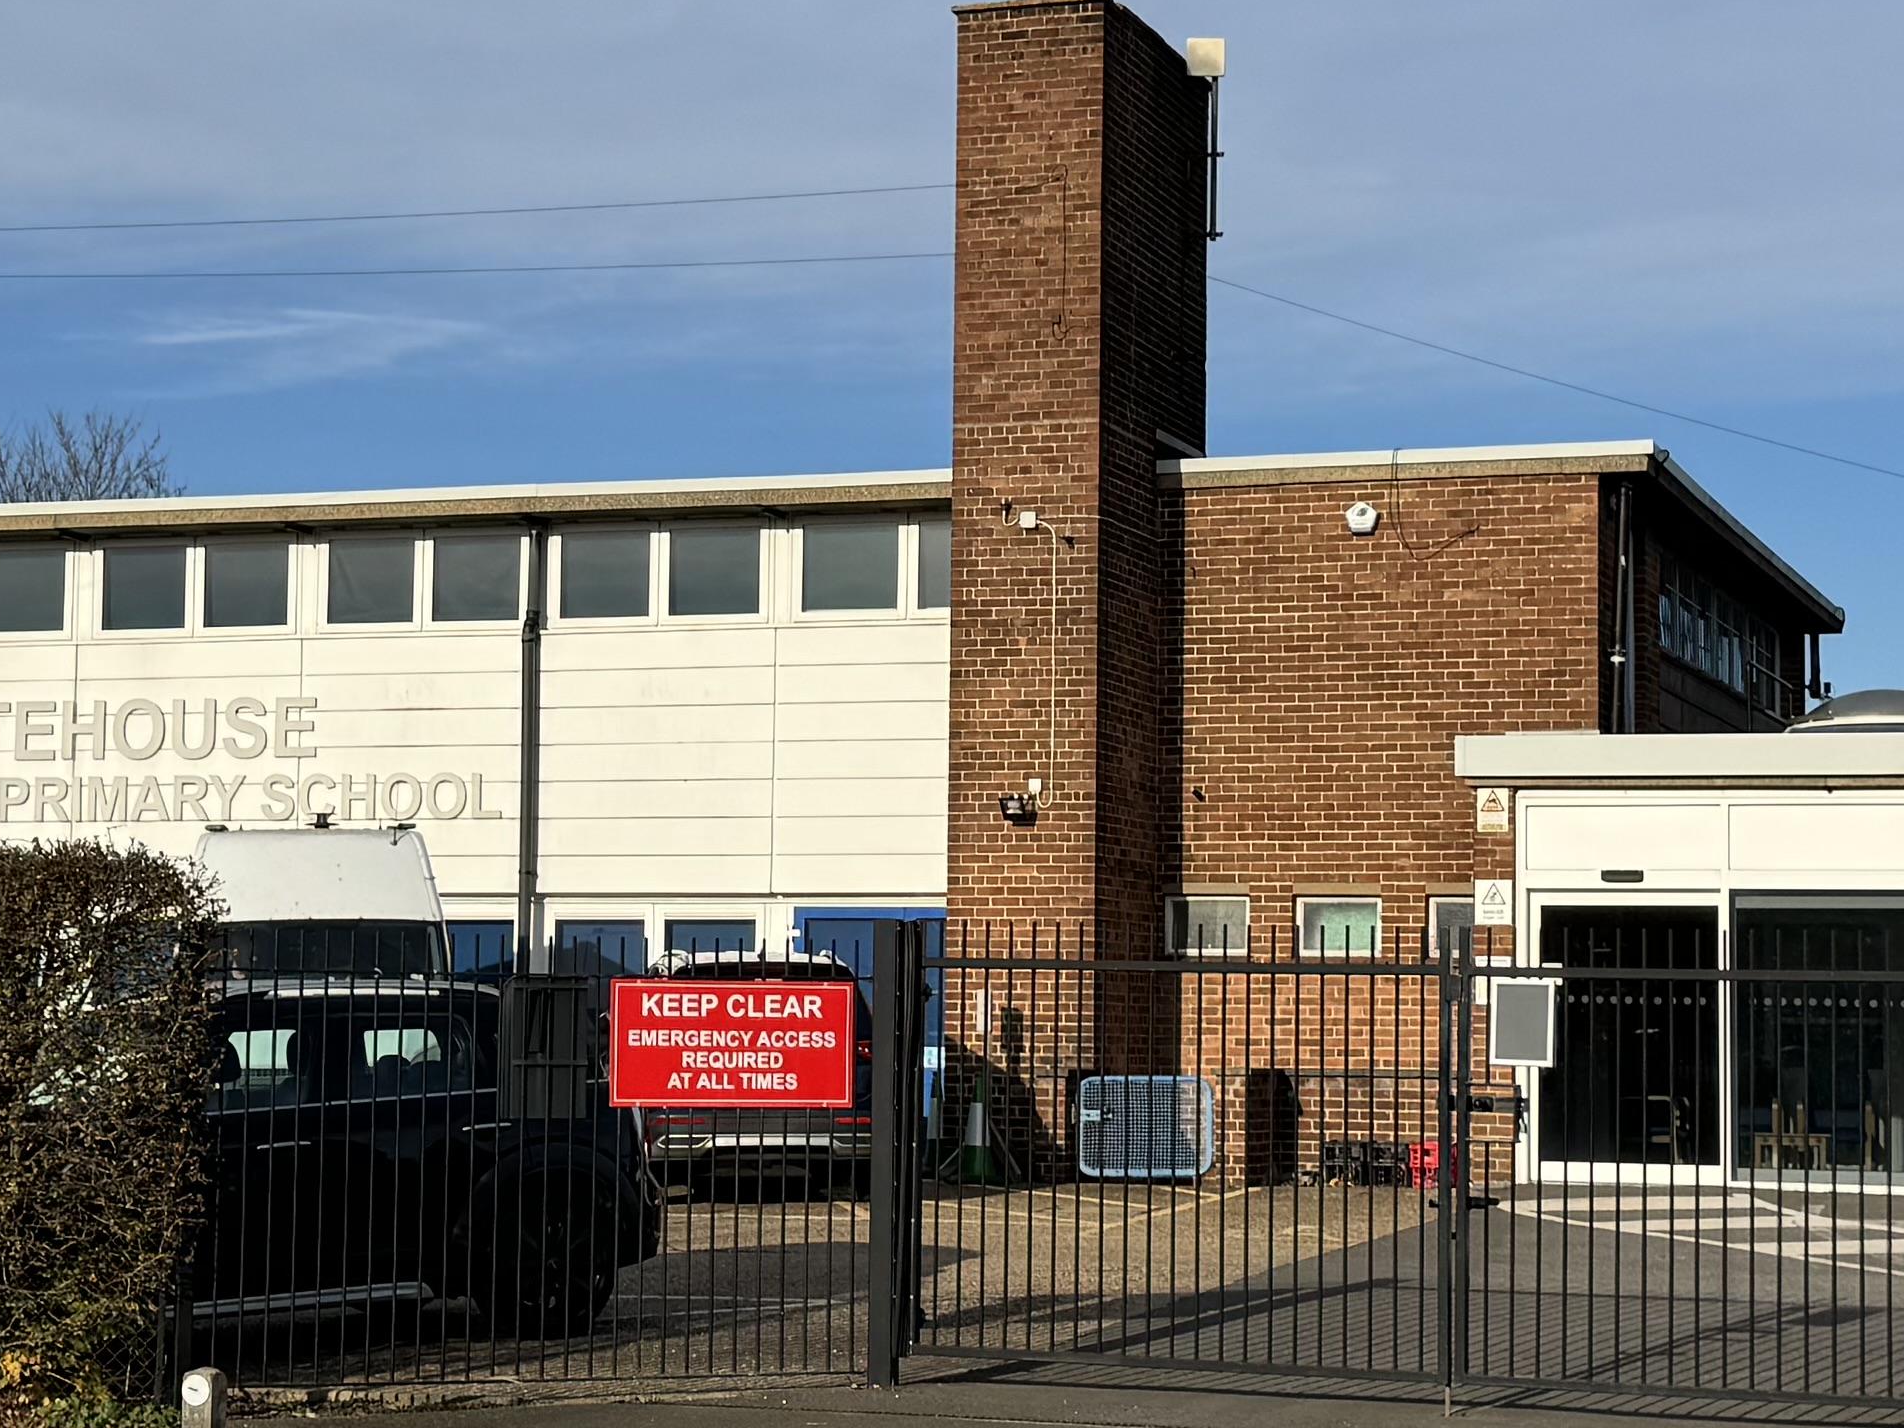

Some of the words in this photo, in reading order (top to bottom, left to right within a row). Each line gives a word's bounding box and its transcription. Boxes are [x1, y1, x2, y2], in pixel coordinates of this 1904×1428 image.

[262, 769, 504, 821] SCHOOL
[641, 993, 719, 1018] KEEP
[726, 994, 823, 1019] CLEAR
[628, 1030, 755, 1048] EMERGENCY
[756, 1031, 836, 1048] ACCESS
[681, 1051, 783, 1069] REQUIRED
[667, 1072, 692, 1090] AT
[696, 1072, 734, 1090] ALL
[739, 1072, 798, 1090] TIMES
